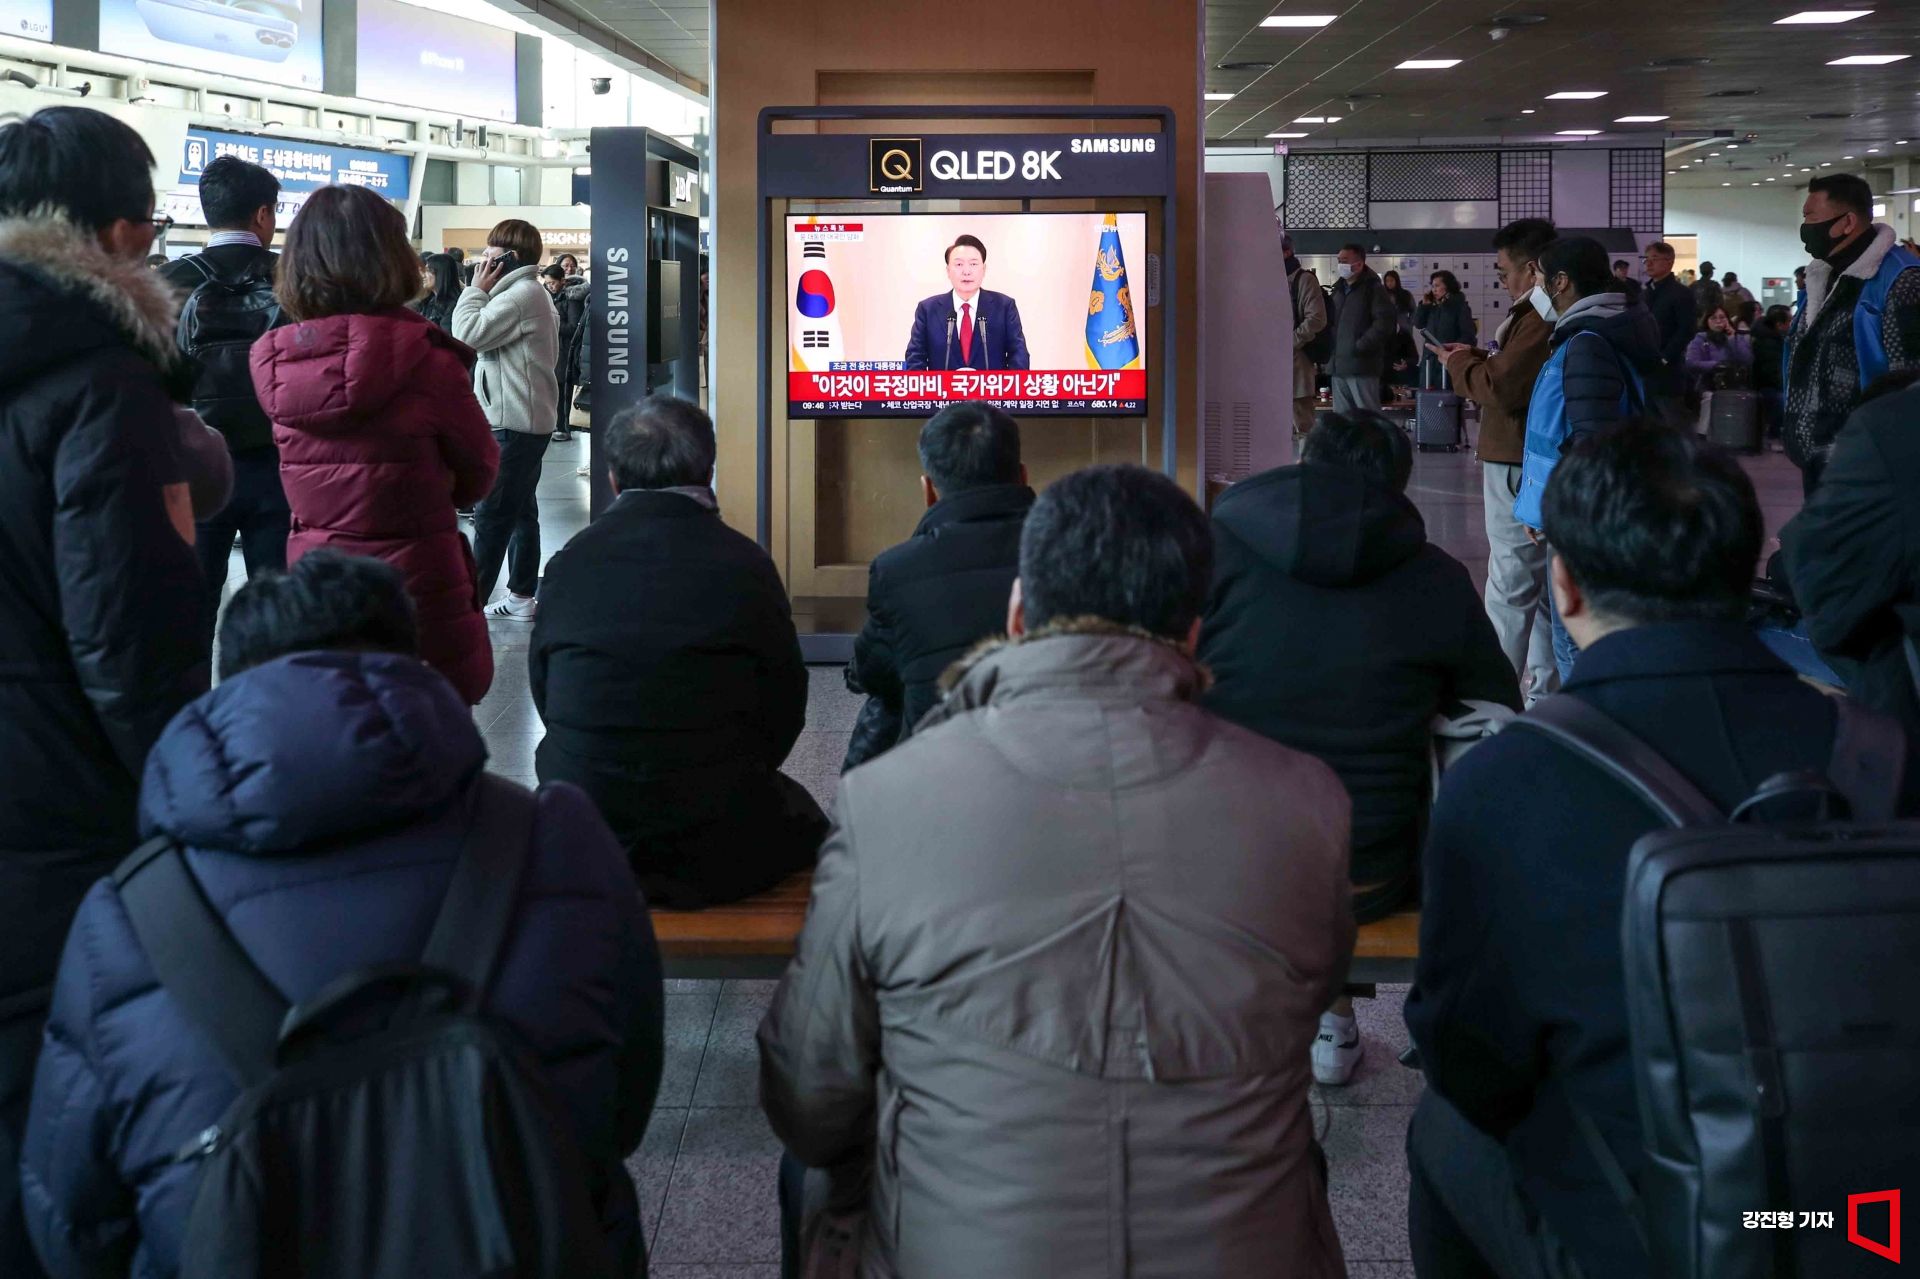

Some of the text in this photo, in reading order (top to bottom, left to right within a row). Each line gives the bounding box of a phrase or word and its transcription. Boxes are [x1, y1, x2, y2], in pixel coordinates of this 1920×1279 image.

[1070, 138, 1156, 154] SAMSUNG
[930, 150, 1063, 181] QLED 8K
[880, 185, 913, 193] Quantum
[540, 232, 577, 245] ESIGN
[606, 247, 629, 385] SAMSUNG
[832, 362, 903, 371] 조금 전 용산 대통령실
[812, 372, 1121, 399] "이것이 국정마비, 국가위기 상황 아닌가"
[802, 401, 825, 410] 09:46
[840, 401, 863, 410] 받는다
[886, 400, 900, 409] 체코
[903, 400, 931, 410] 산업국장
[1003, 400, 1018, 409] 계약
[1019, 400, 1034, 409] 일정
[1035, 400, 1050, 409] 지연
[1067, 400, 1086, 409] 코스닥
[1091, 400, 1118, 409] 680.14
